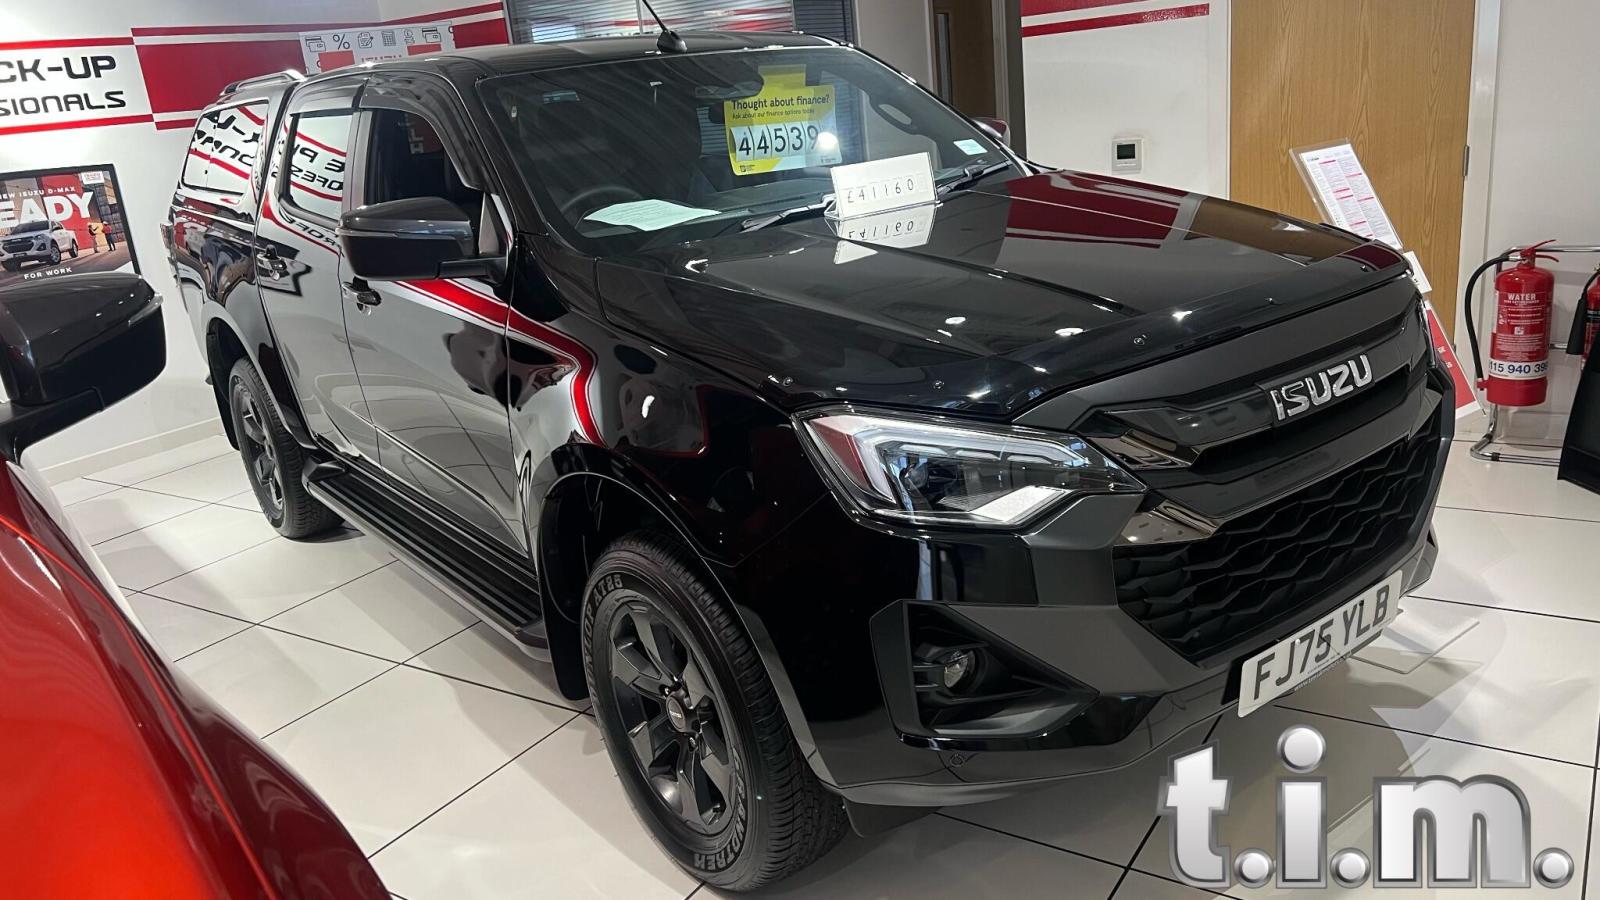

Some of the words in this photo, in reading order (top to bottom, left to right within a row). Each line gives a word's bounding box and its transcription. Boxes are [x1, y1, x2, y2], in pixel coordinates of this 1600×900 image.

[732, 98, 768, 110] Thought
[769, 97, 795, 107] about
[796, 95, 830, 105] finance?
[742, 111, 756, 119] about
[738, 125, 820, 156] 44539
[19, 189, 45, 198] ISUZU
[47, 186, 76, 194] D-MAX
[847, 178, 914, 203] £41160
[24, 271, 43, 280] FOR
[45, 267, 73, 276] WORK
[1507, 292, 1536, 301] WATER
[1507, 364, 1531, 374] 940
[1269, 354, 1373, 421] ISUZU
[1253, 618, 1334, 701] FJ75
[1342, 584, 1390, 647] YLB
